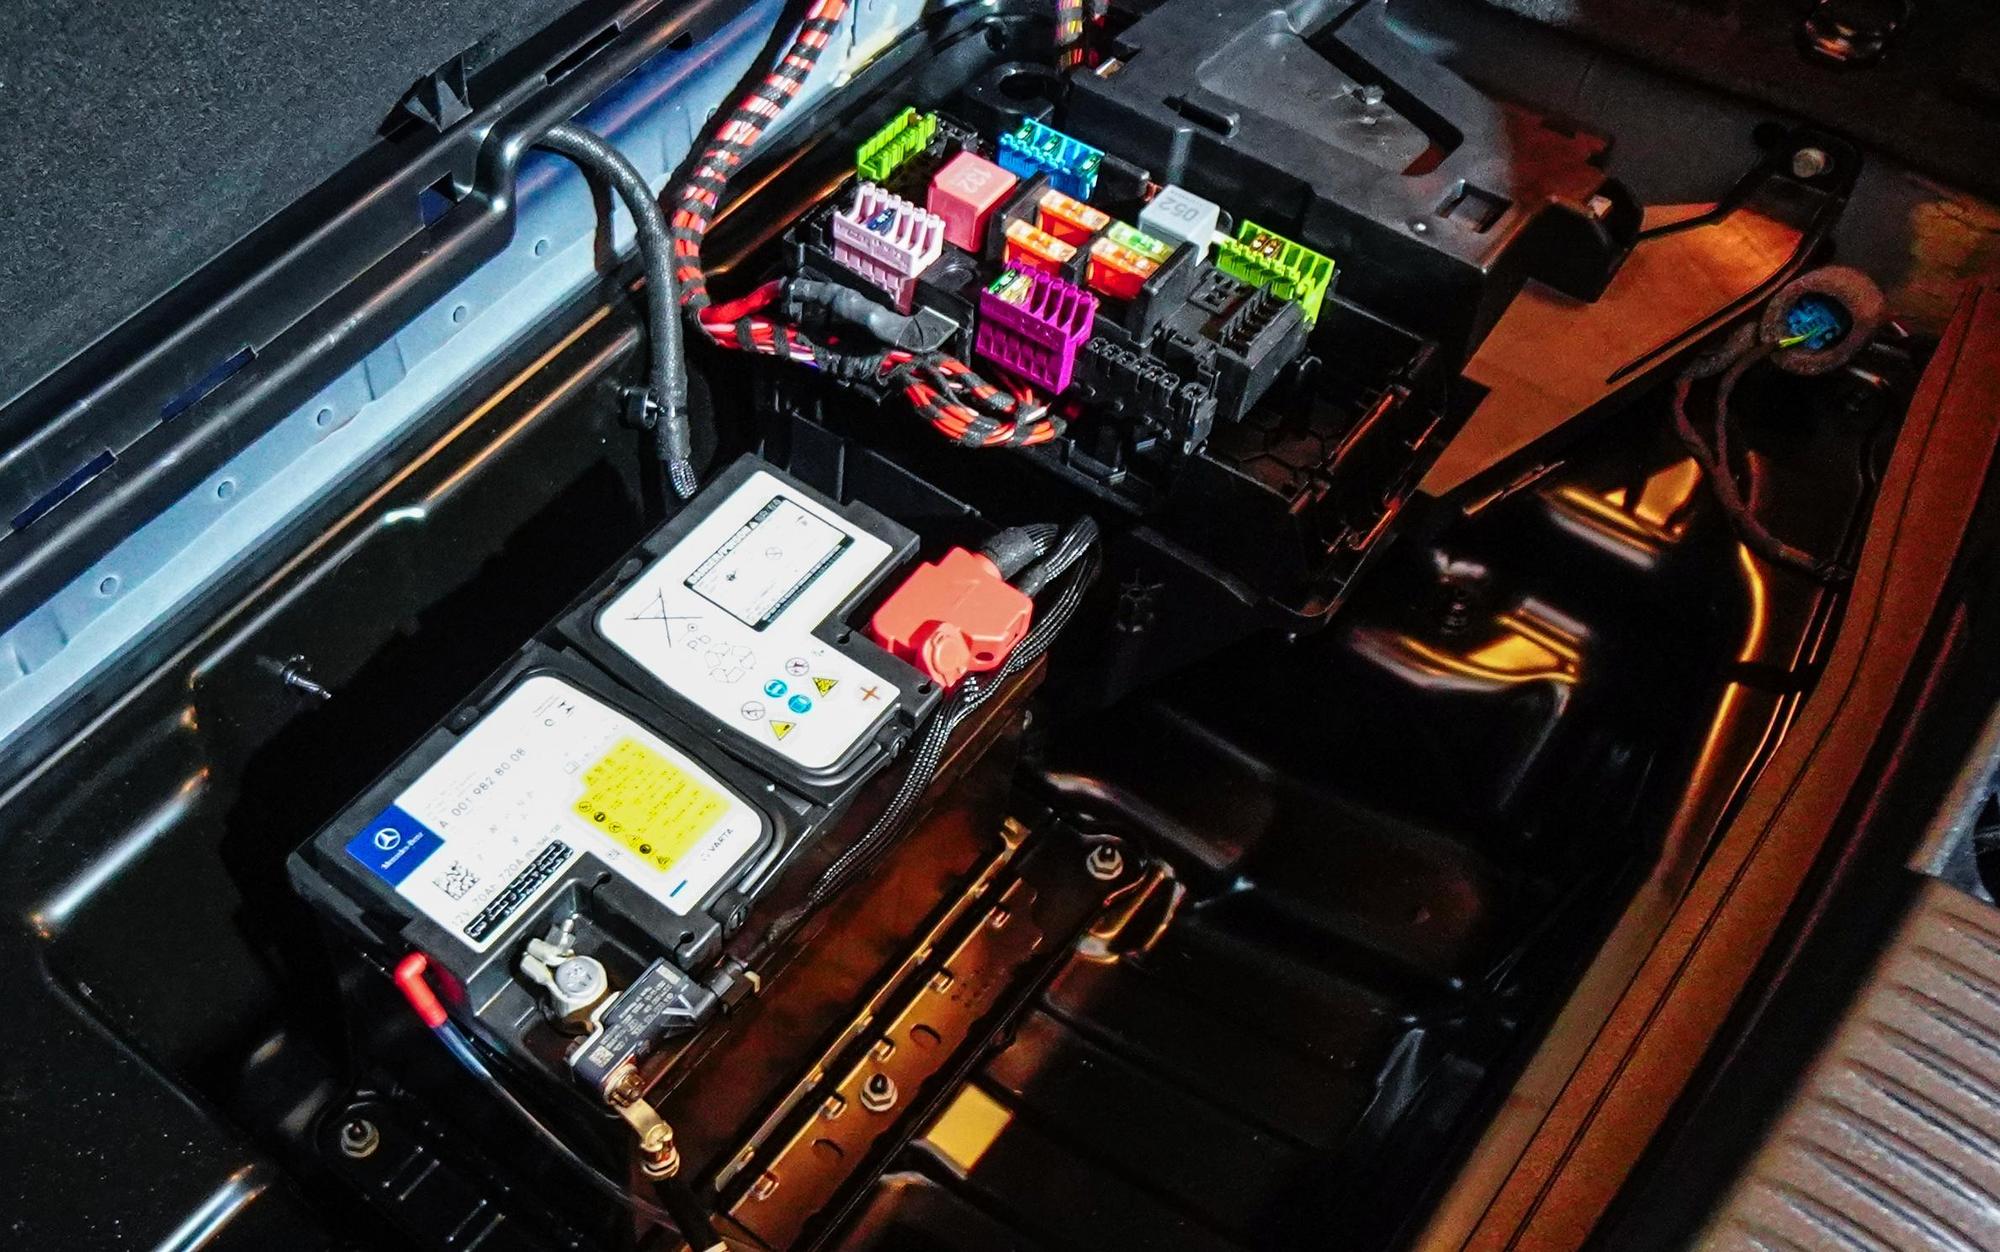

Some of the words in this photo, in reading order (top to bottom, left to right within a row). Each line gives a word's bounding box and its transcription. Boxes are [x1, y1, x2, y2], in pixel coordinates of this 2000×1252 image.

[1159, 196, 1200, 222] 052
[451, 797, 472, 817] 001
[473, 776, 495, 796] 982
[494, 761, 511, 776] 80
[381, 831, 424, 870] Mercedes-Benz
[707, 827, 734, 852] VARTA
